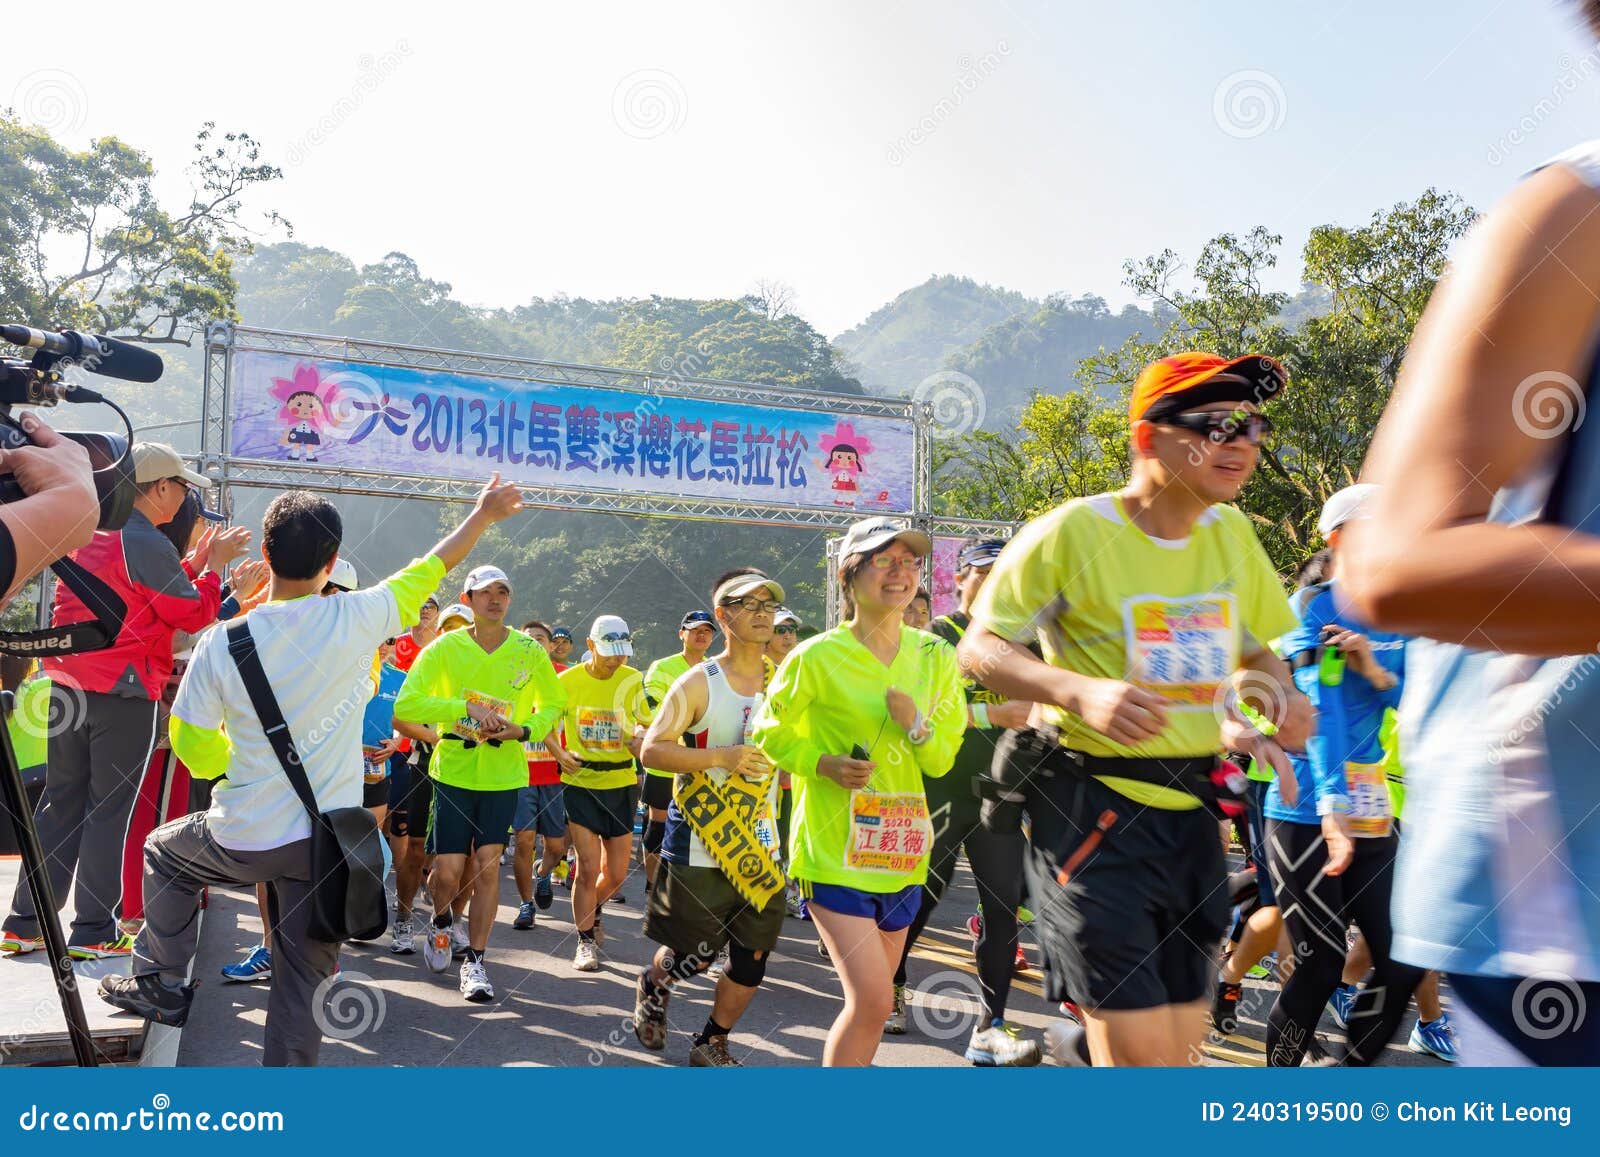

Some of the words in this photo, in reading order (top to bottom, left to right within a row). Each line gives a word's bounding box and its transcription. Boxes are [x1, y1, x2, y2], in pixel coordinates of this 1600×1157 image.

[883, 818, 912, 828] 5020
[858, 828, 925, 854] 江毅薇
